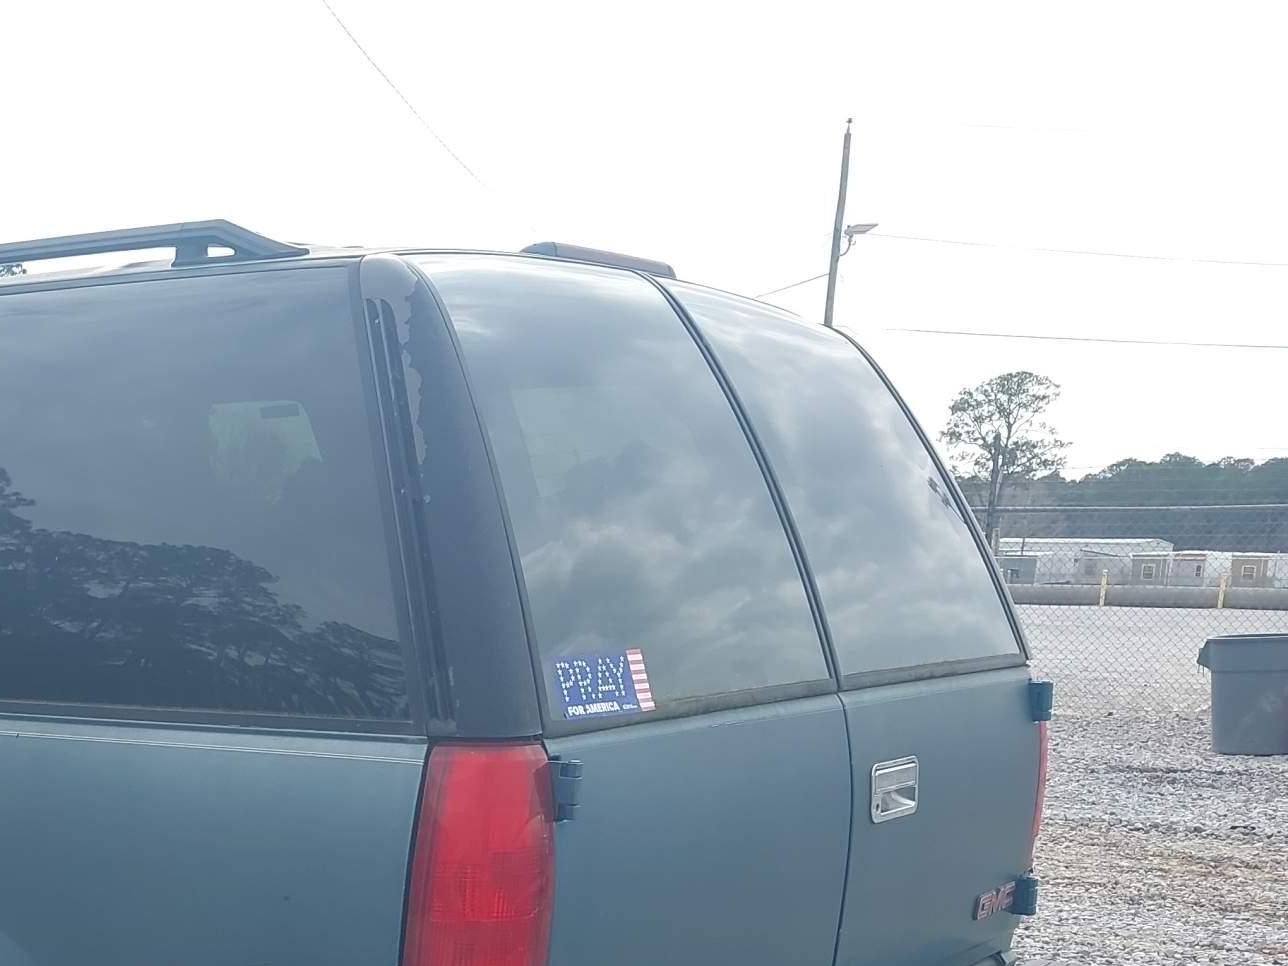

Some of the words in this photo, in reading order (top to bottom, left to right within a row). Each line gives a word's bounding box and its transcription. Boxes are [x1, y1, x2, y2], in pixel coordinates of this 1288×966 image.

[556, 655, 626, 702] PRAY
[567, 704, 586, 716] FOR
[586, 701, 621, 714] AMERICA
[976, 881, 1016, 921] GMC
